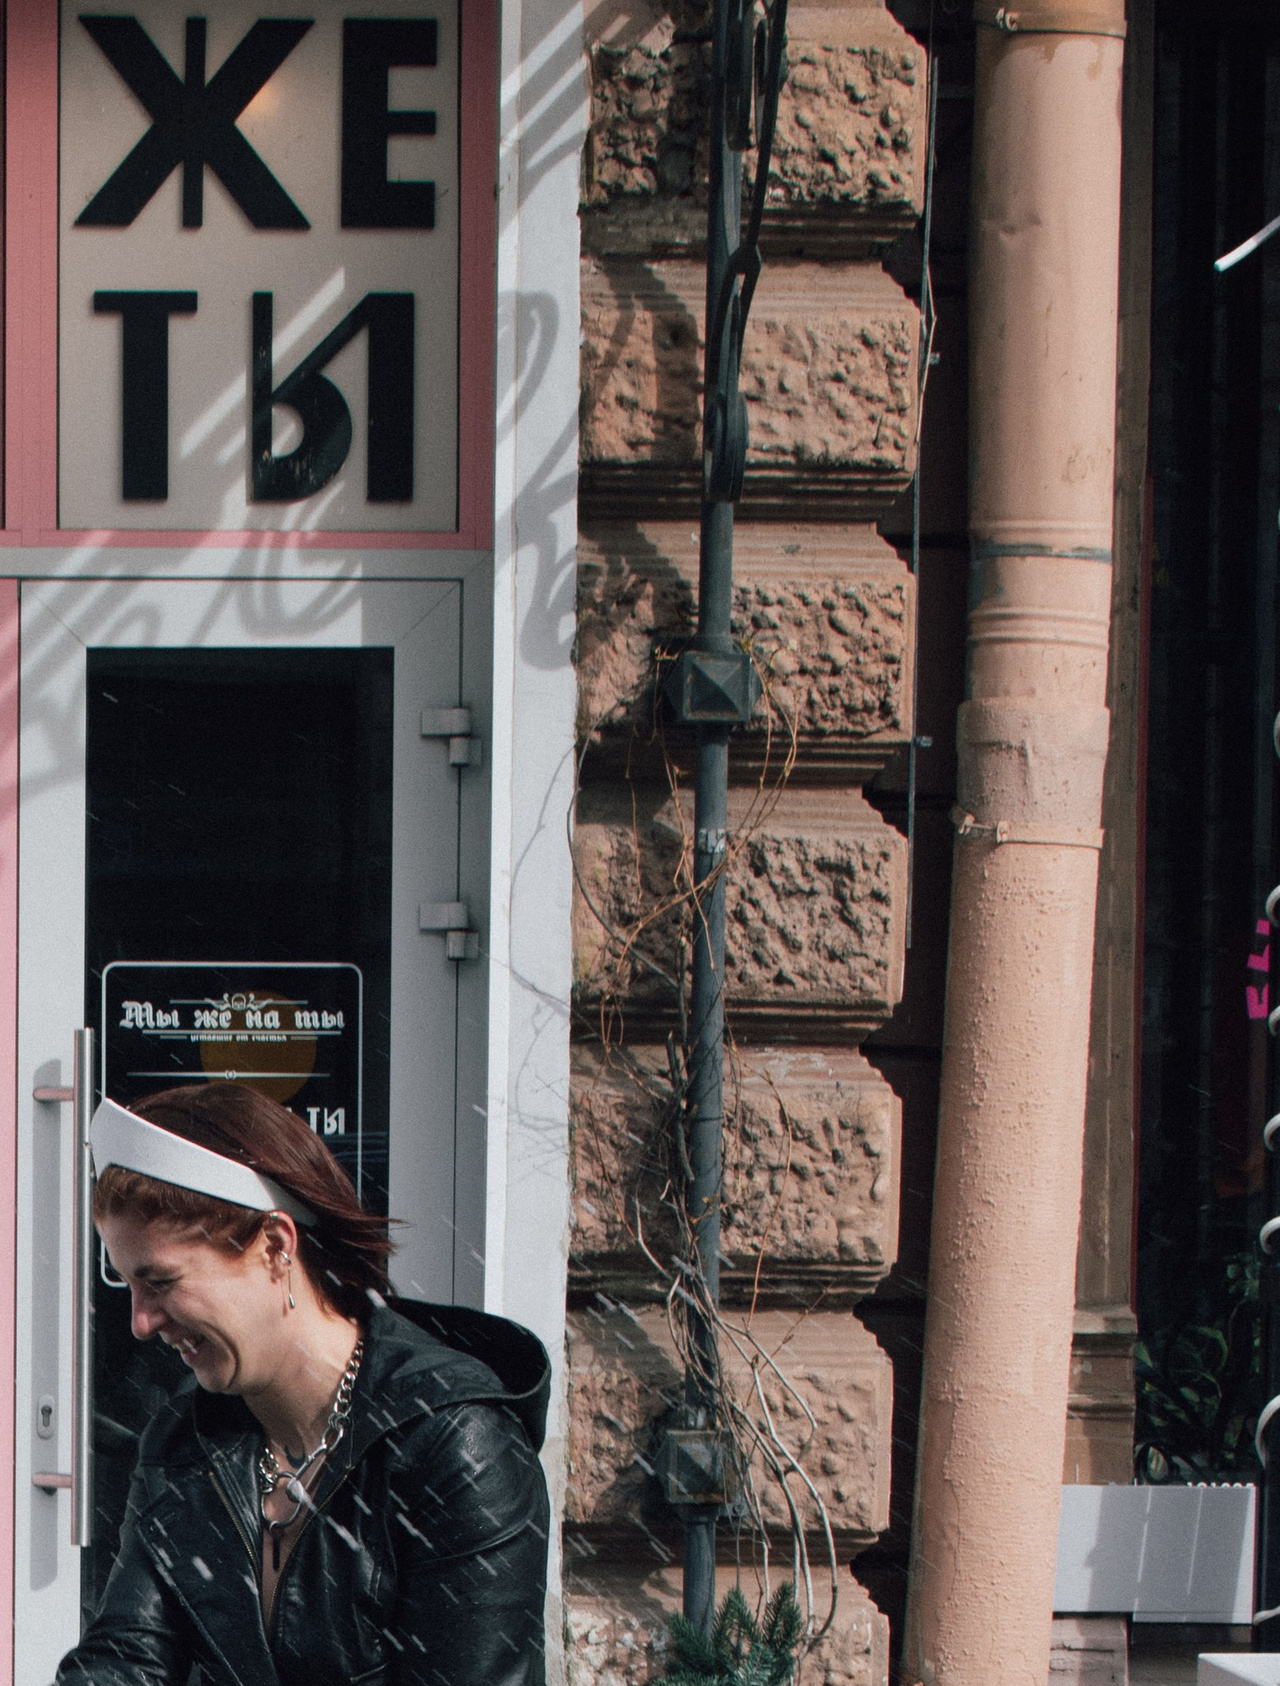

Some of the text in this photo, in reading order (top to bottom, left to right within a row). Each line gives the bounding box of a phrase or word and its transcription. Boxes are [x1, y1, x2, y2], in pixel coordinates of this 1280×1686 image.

[74, 15, 439, 229] ЖЕ
[93, 291, 416, 503] ТЫ
[120, 1001, 346, 1029] Мы же на ты
